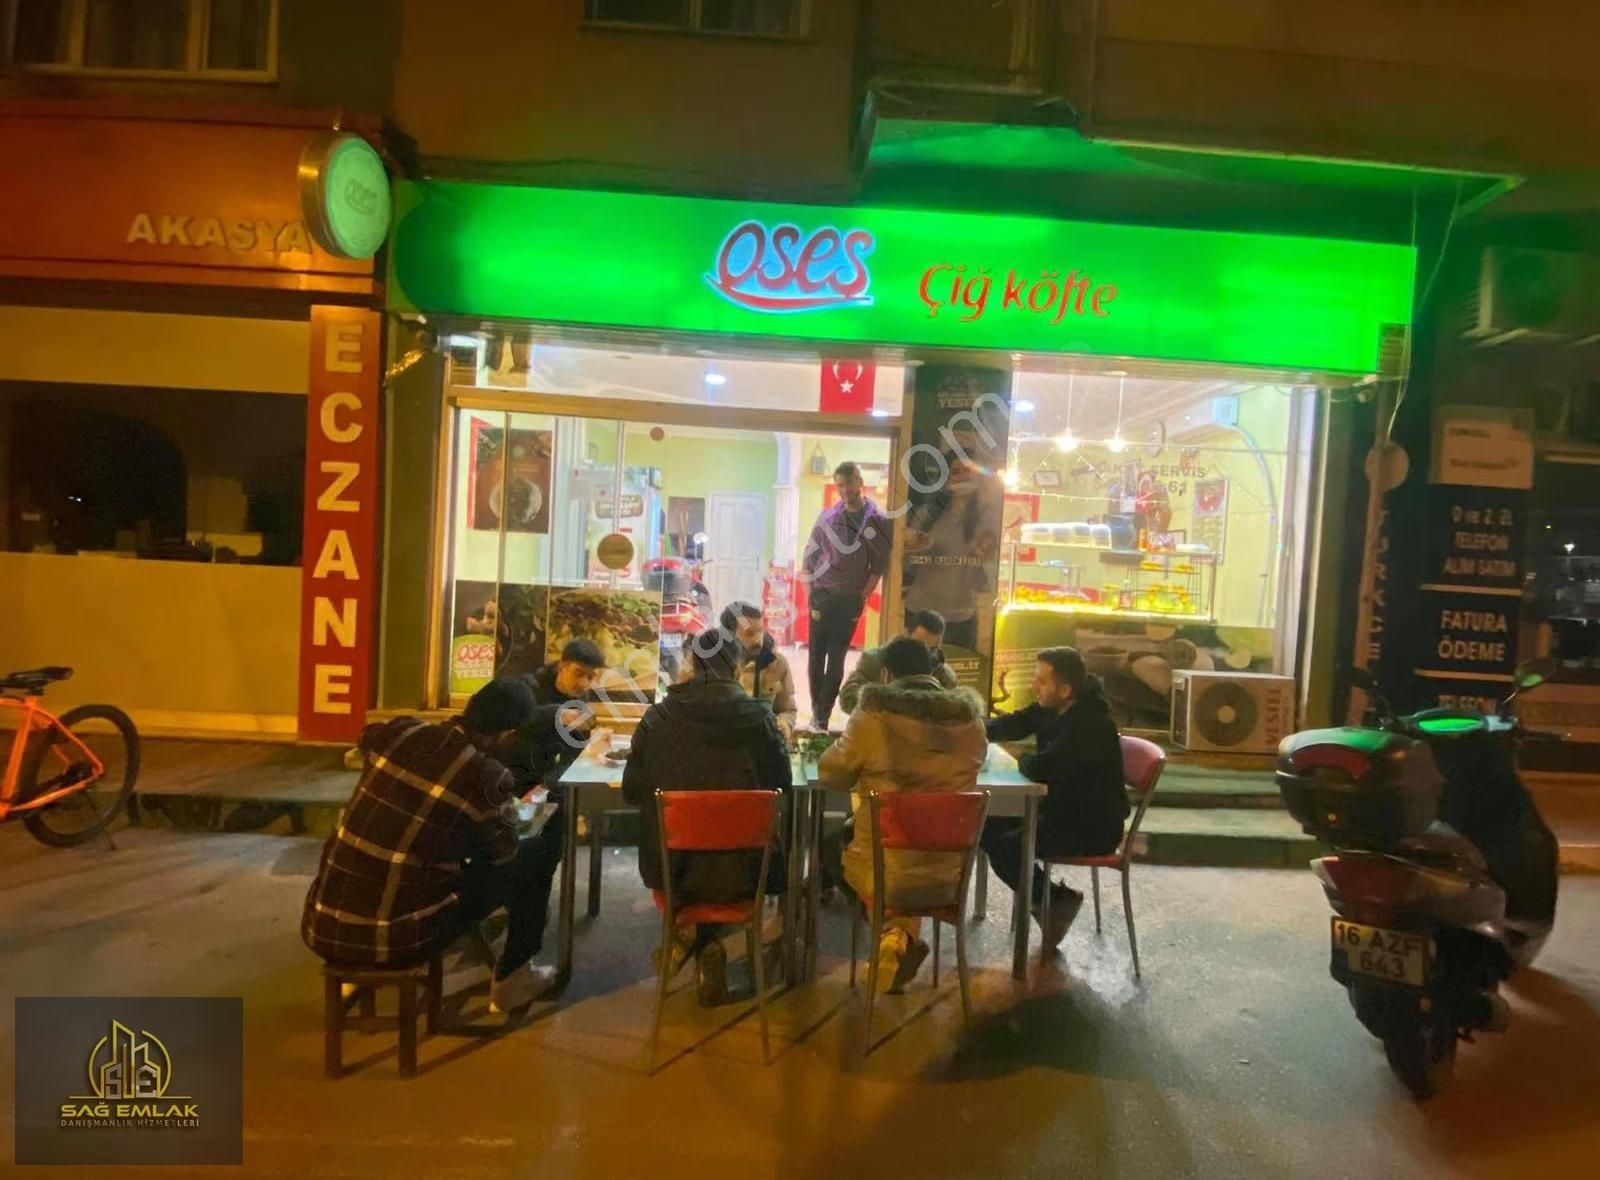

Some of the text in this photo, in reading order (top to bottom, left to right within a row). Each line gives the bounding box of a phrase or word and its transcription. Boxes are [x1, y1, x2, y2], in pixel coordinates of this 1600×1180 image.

[126, 213, 313, 255] AKASYA
[919, 263, 1119, 326] Çiğ köfte
[312, 322, 364, 715] ECZANE
[1440, 610, 1508, 633] FATURA
[1437, 634, 1505, 662] ÖDEME
[1337, 922, 1361, 946] 16
[1359, 950, 1405, 979] 643
